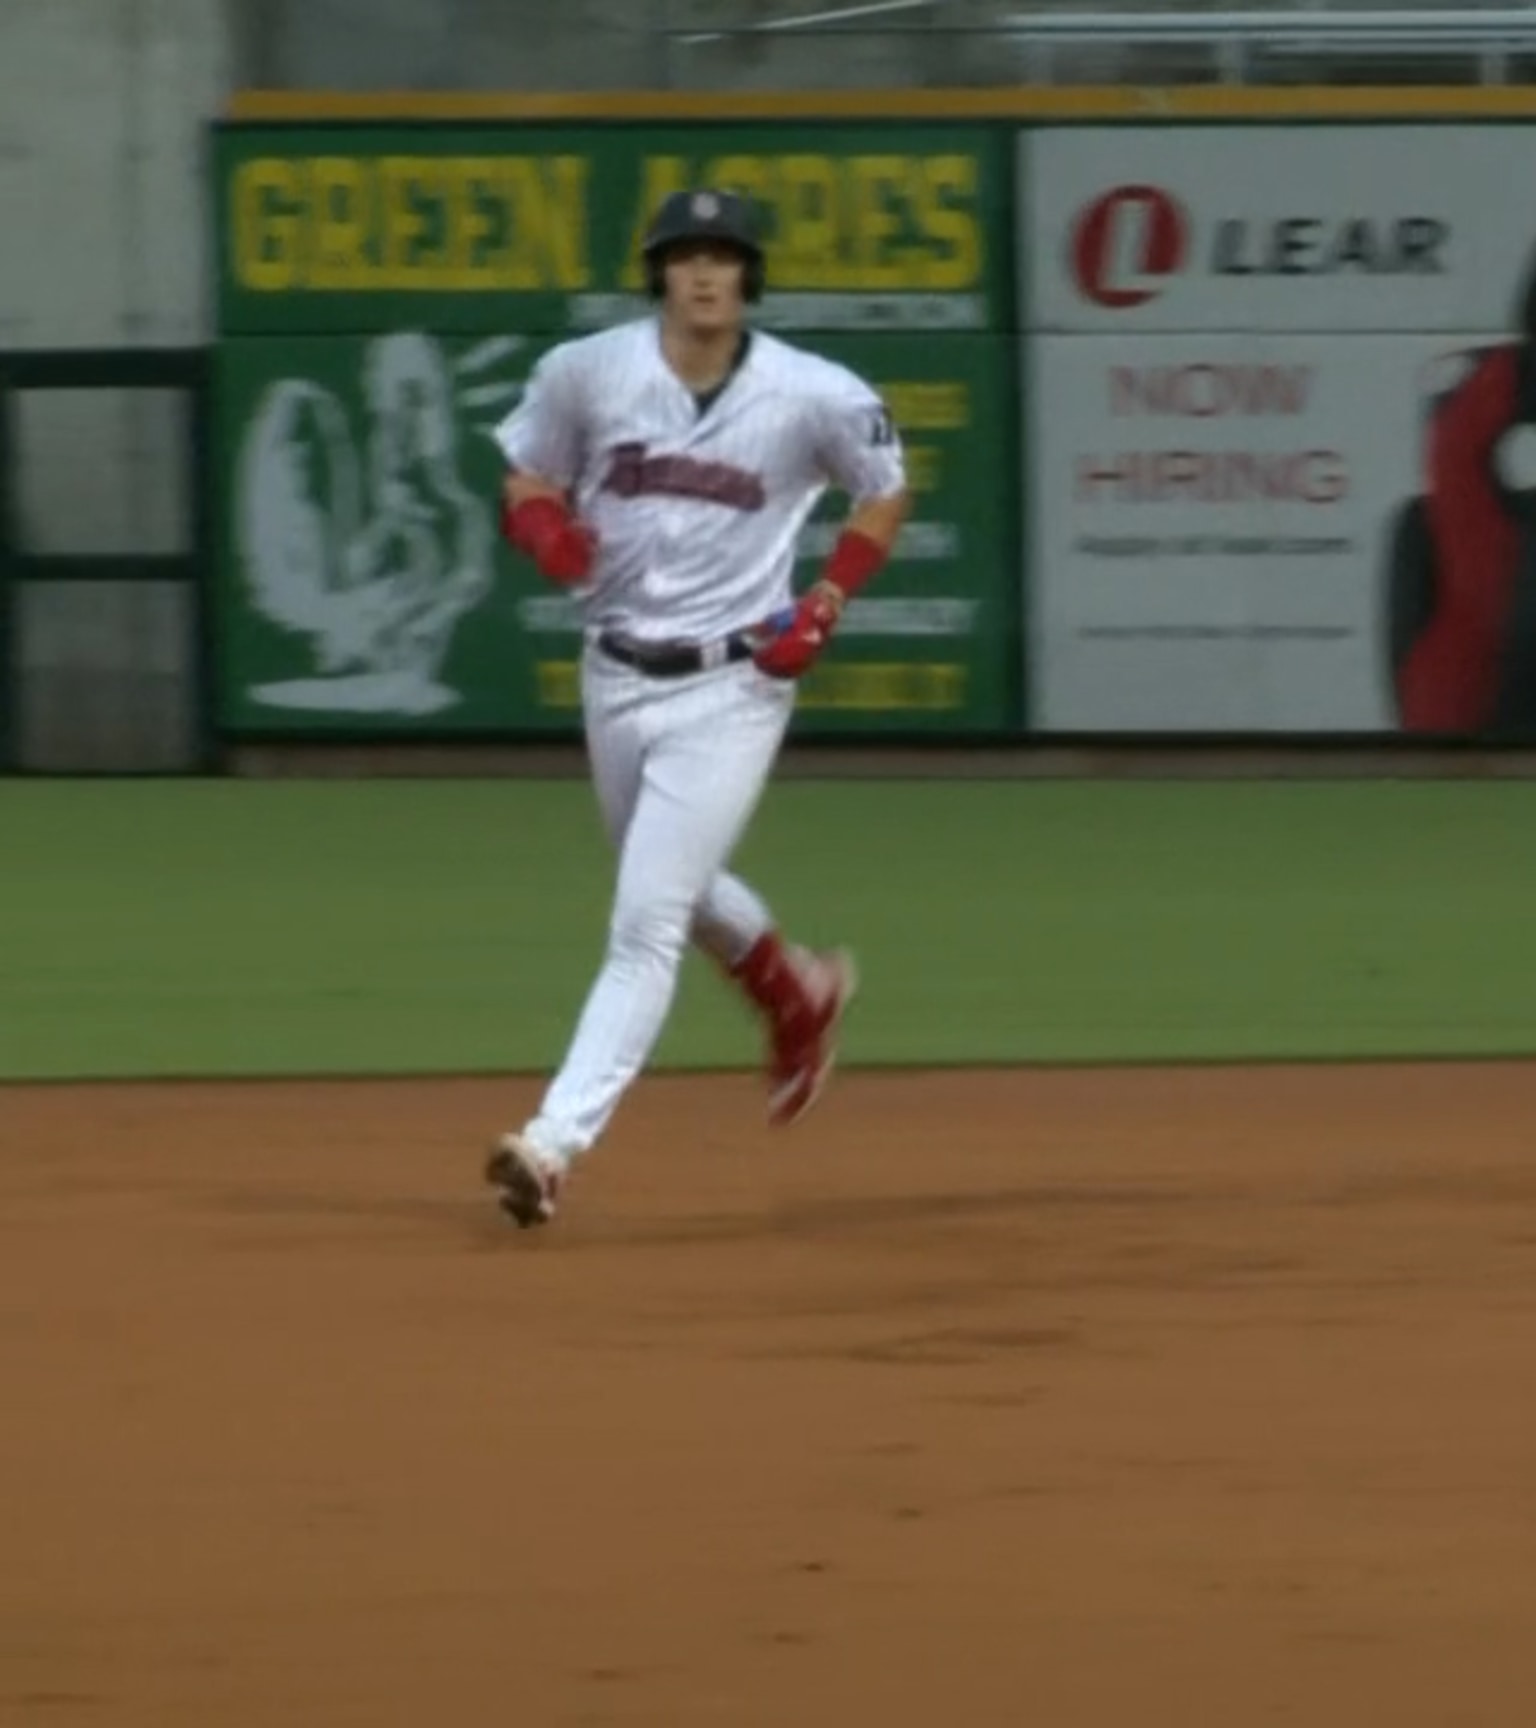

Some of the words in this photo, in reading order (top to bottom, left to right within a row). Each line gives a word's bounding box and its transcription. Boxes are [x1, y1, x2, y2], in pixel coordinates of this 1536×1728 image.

[233, 153, 590, 290] GREEN
[1212, 217, 1449, 276] LEAR
[1107, 363, 1318, 417] NOW
[1072, 450, 1350, 504] HIRING
